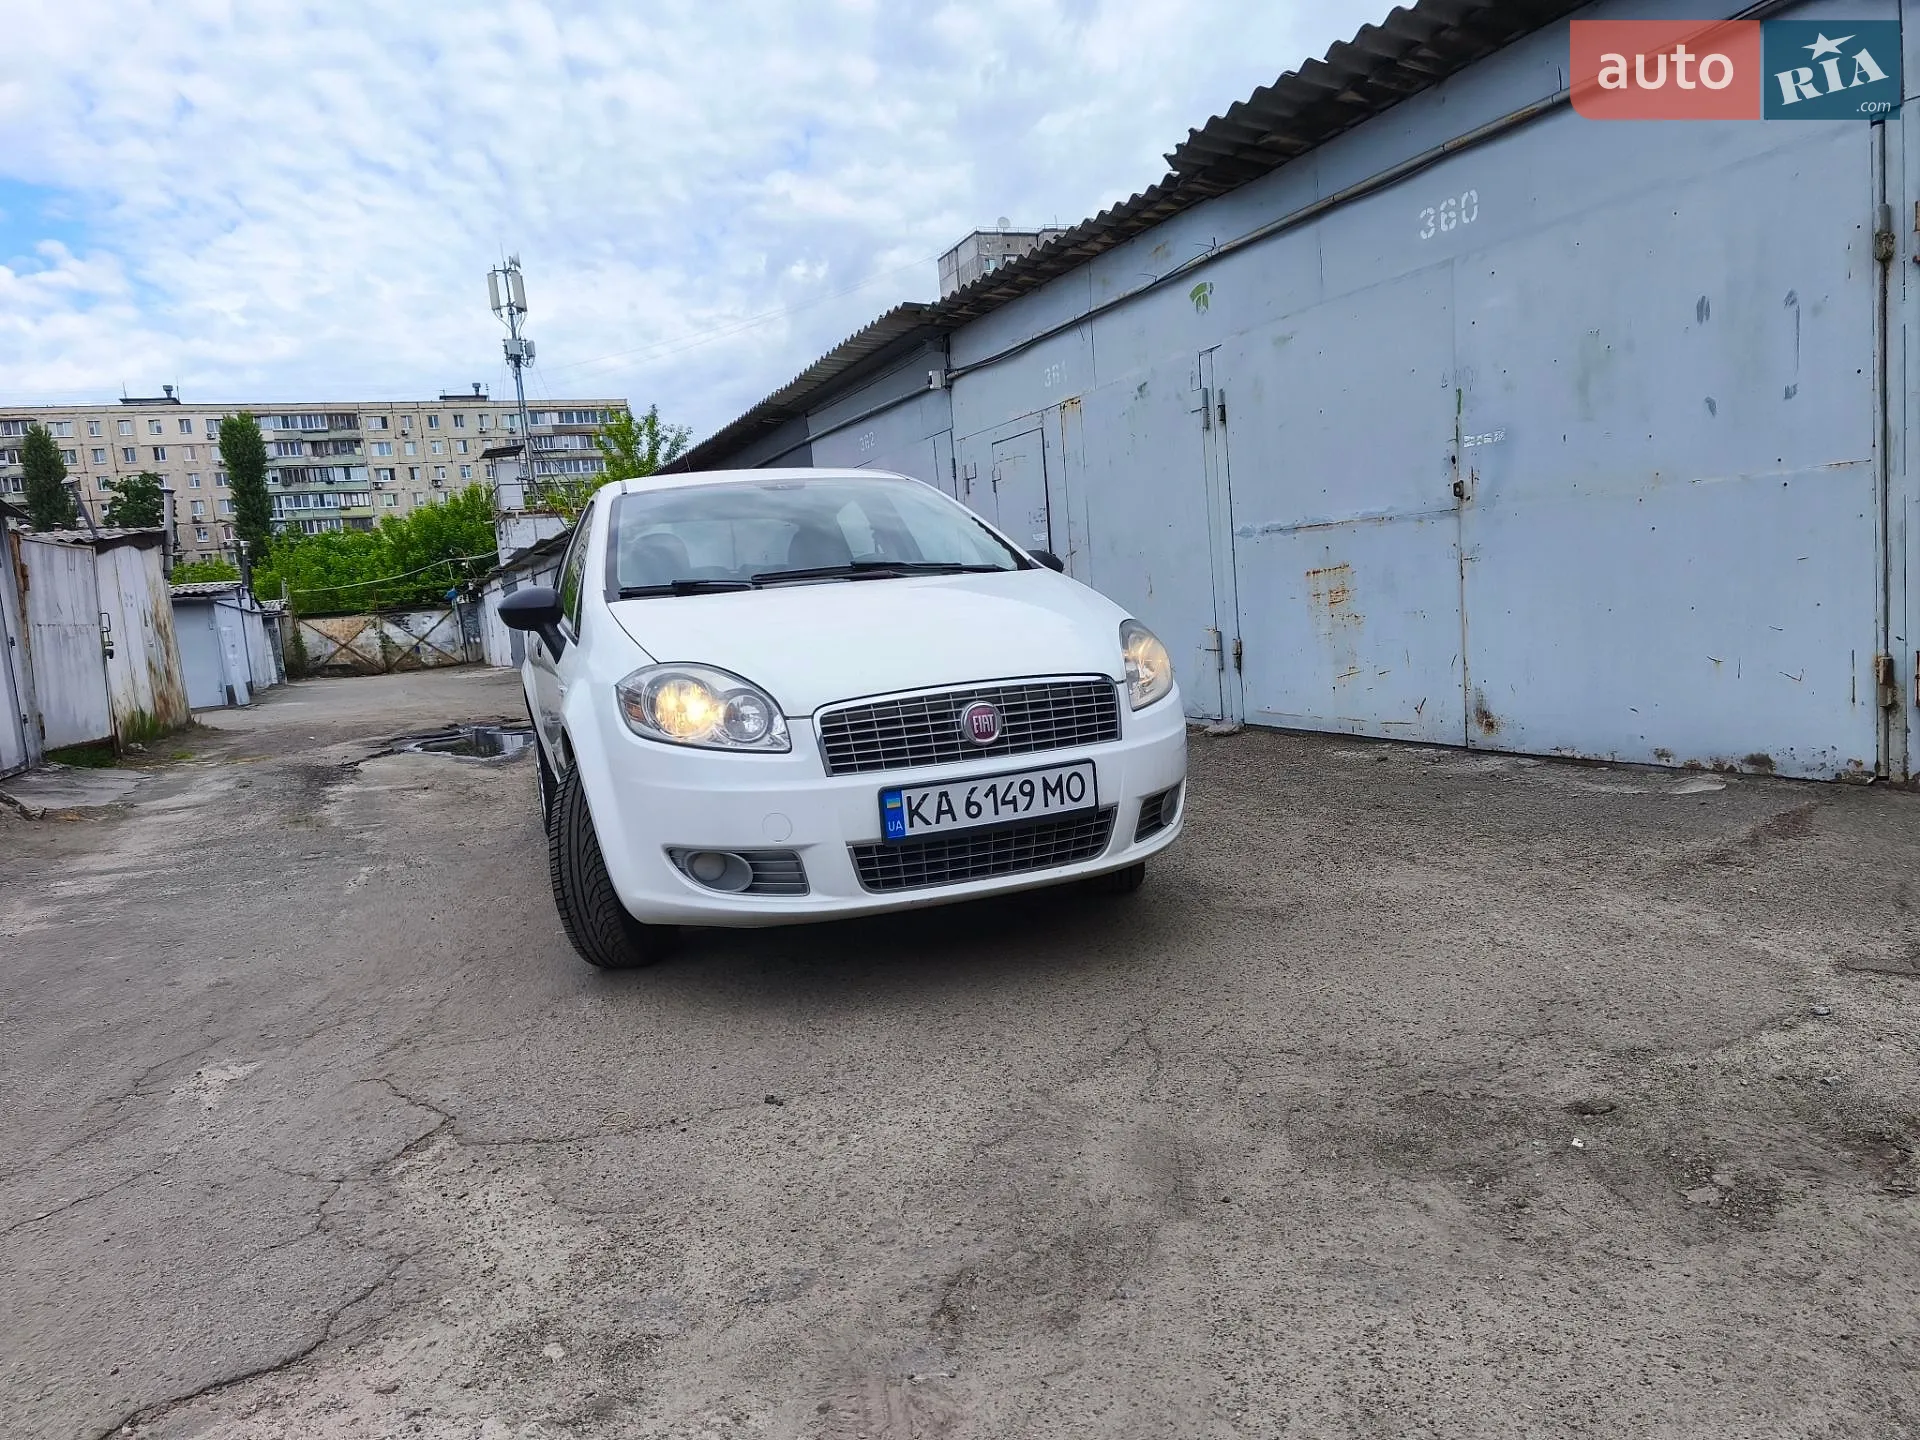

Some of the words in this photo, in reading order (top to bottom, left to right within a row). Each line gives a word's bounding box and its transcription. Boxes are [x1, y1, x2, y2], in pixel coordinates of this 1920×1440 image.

[1420, 189, 1479, 239] 360
[973, 714, 994, 733] FIAT
[906, 791, 957, 828] KA
[965, 778, 1035, 819] 6149
[1041, 771, 1086, 807] MO
[888, 821, 904, 832] UA
